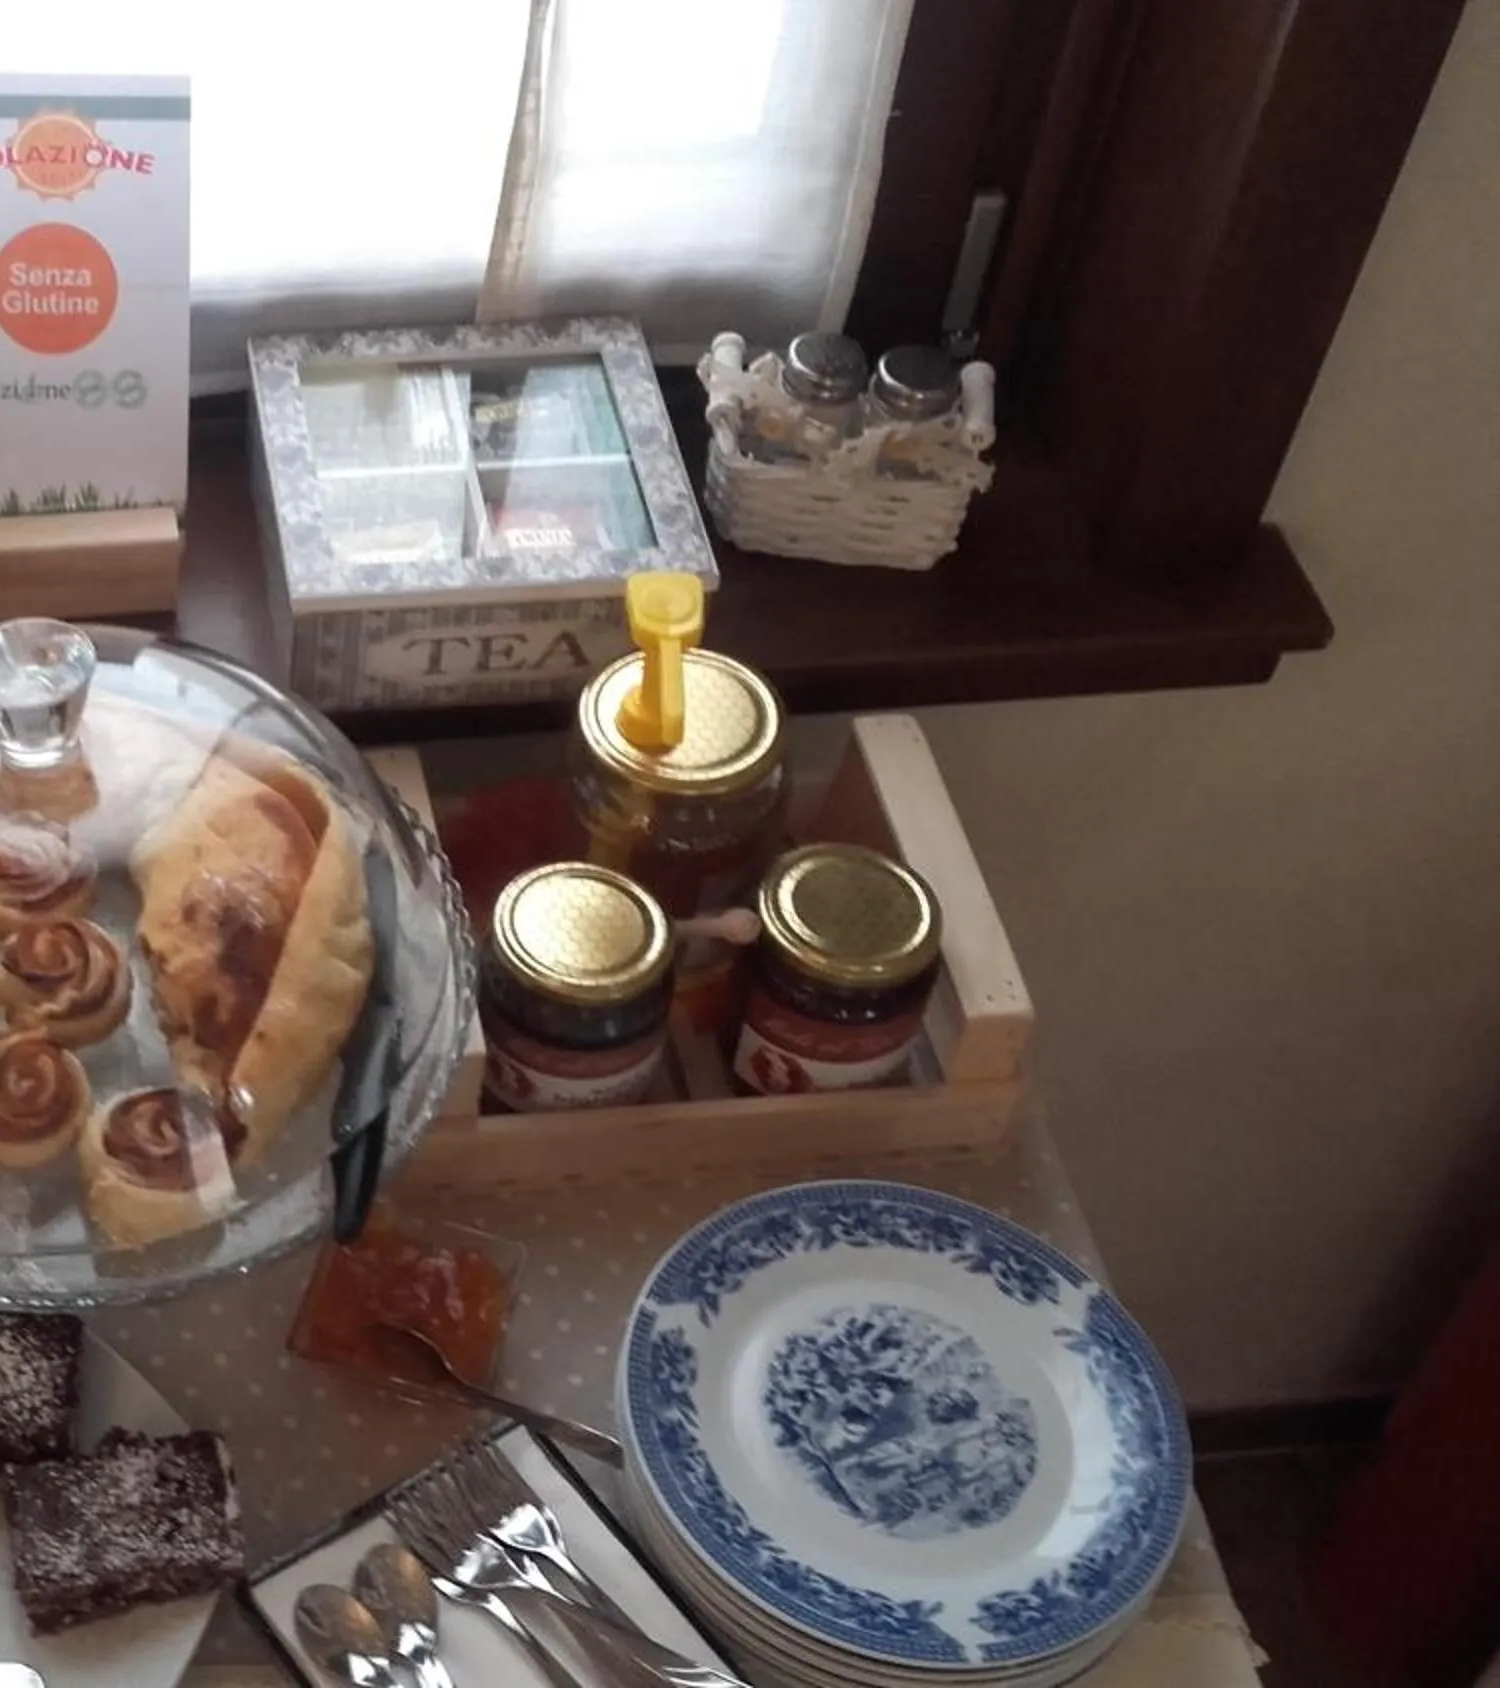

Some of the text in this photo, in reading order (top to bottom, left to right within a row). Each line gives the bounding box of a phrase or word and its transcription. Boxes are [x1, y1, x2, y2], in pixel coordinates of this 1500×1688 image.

[9, 263, 92, 287] Senza
[2, 291, 99, 316] Glutine
[403, 630, 591, 676] TEA
